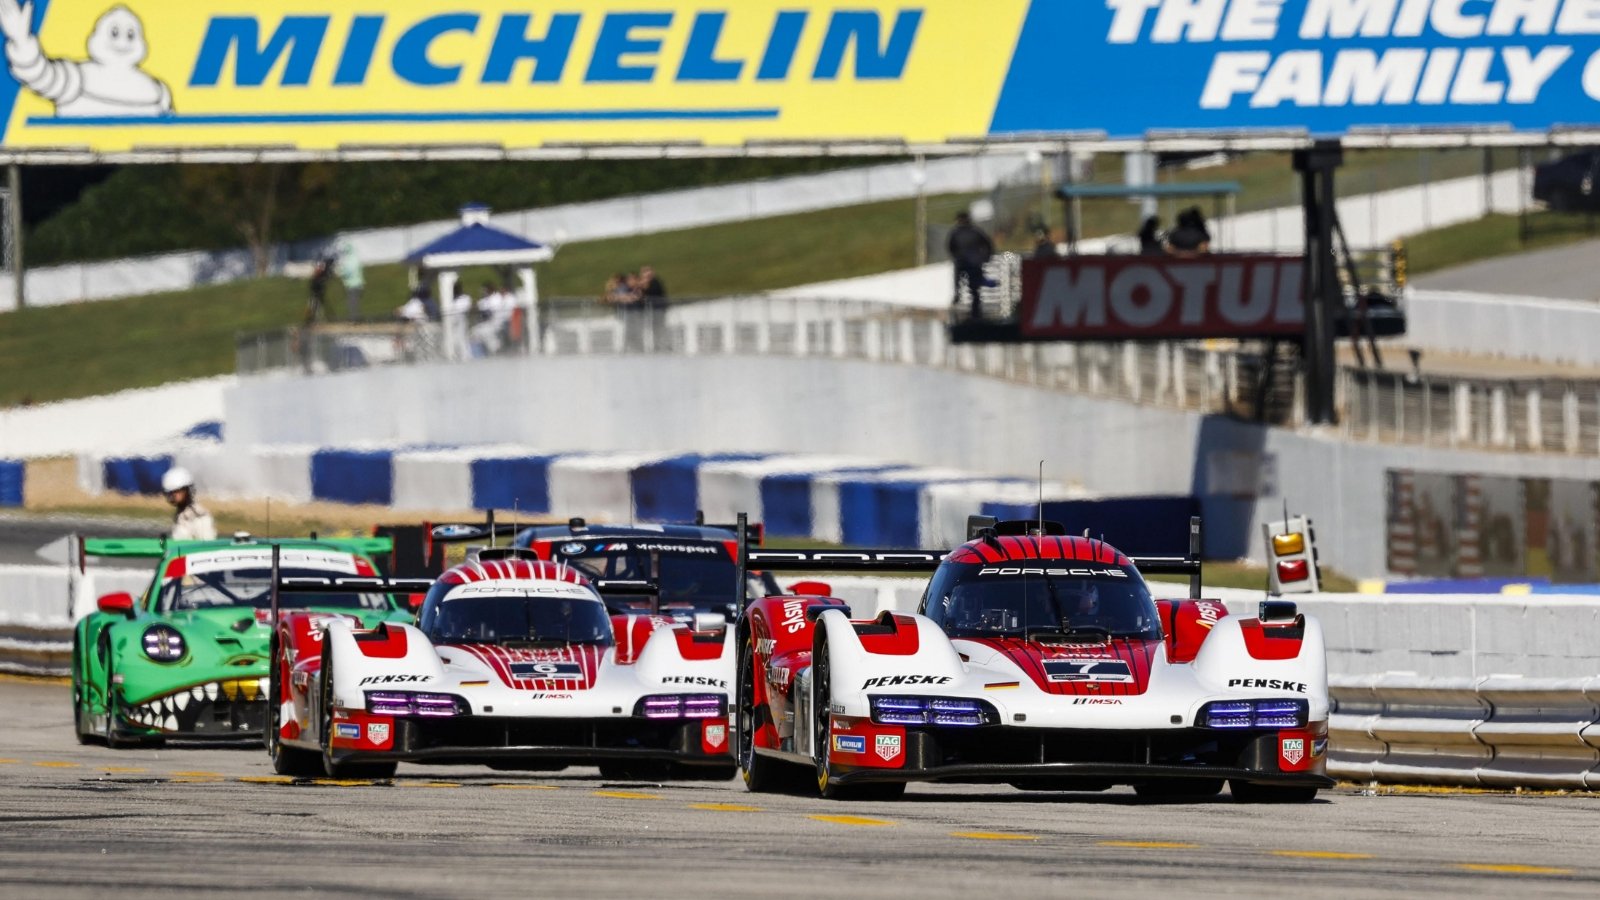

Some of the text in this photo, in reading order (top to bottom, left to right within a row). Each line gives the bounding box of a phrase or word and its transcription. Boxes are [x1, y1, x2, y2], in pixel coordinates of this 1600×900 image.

[1107, 0, 1600, 43] THE MICHE
[188, 10, 923, 87] MICHELIN
[1201, 46, 1573, 108] FAMILY
[1031, 262, 1305, 328] MOTUL
[637, 543, 719, 554] Motorsport
[978, 567, 1128, 577] PORSCHE
[462, 586, 586, 595] PORSCHE
[533, 665, 558, 673] 6
[1070, 661, 1100, 673] 7
[358, 674, 434, 687] PENSKE
[661, 676, 728, 689] PENSKE
[861, 674, 953, 690] PENSKE
[1228, 679, 1308, 693] PENSKE
[877, 736, 899, 745] TAG
[1284, 740, 1302, 749] TAG
[876, 745, 900, 757] HEUER
